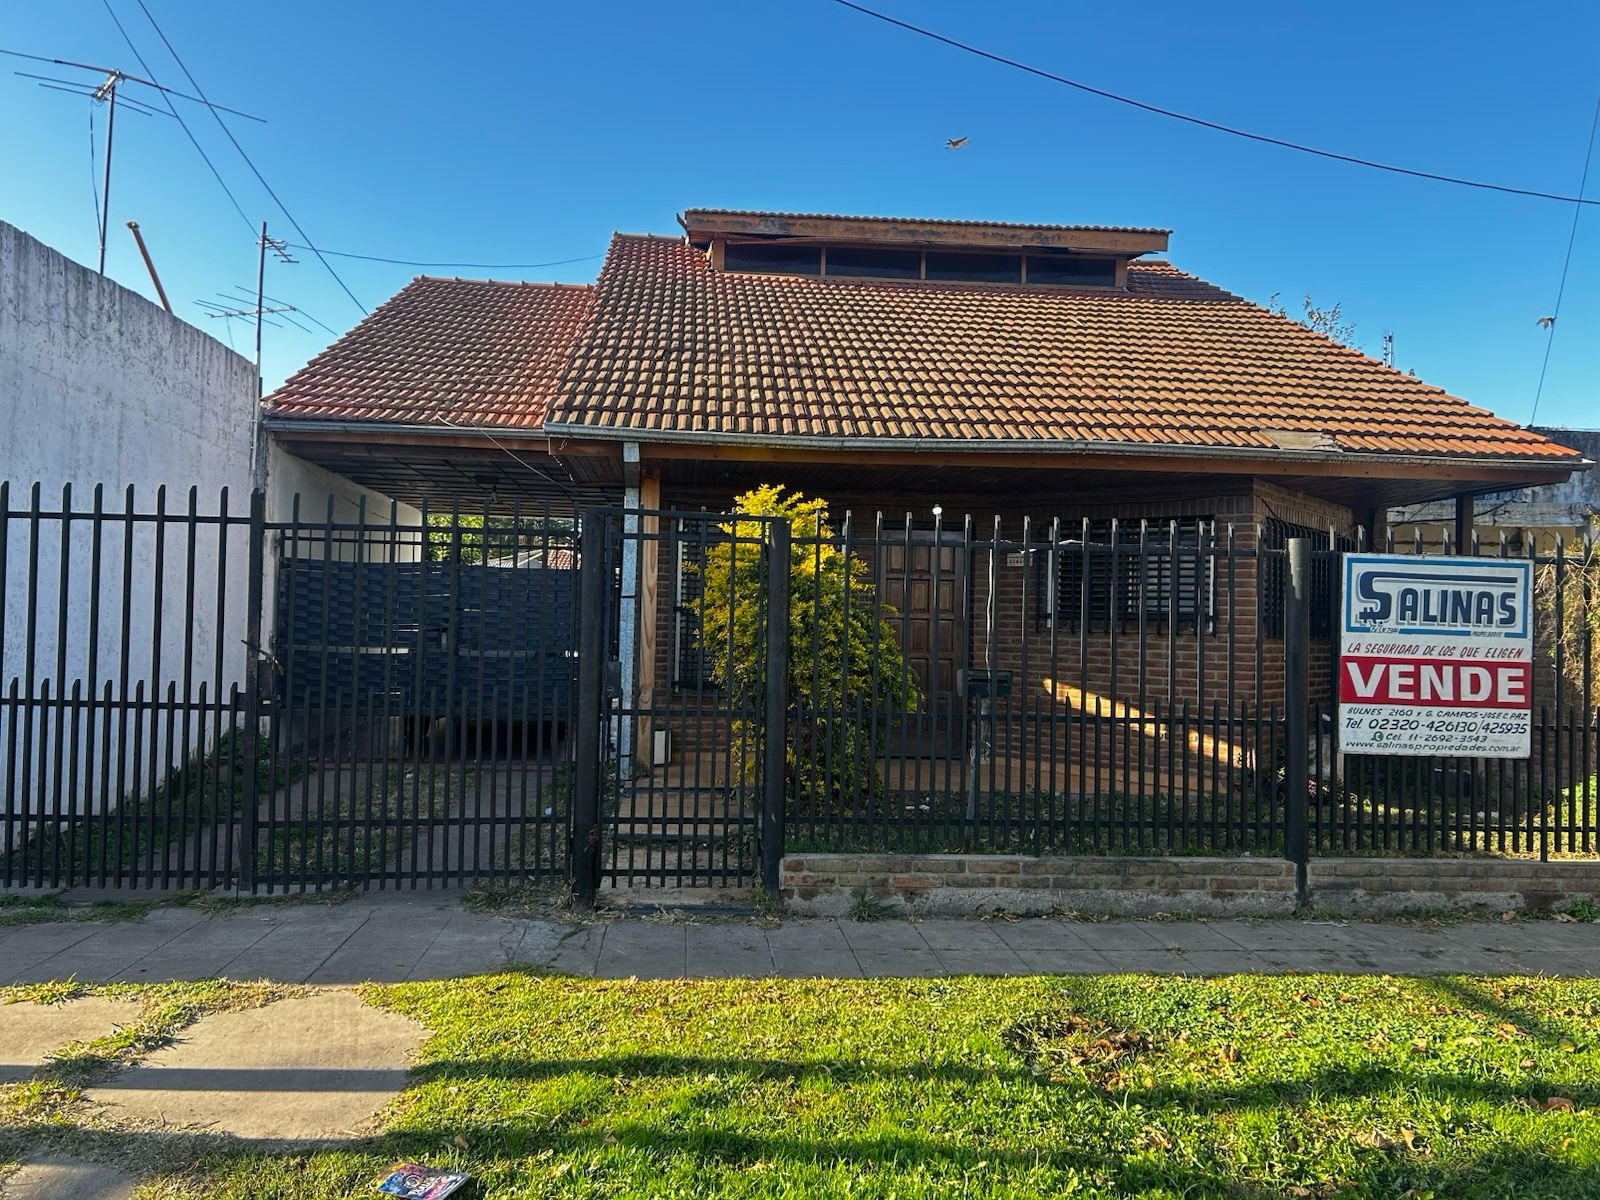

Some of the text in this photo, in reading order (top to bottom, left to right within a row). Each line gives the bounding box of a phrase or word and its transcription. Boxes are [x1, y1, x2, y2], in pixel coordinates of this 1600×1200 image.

[1356, 571, 1517, 628] SALINAS
[1347, 643, 1524, 659] LA SEGURIDAD DE LOS QUE ELIGEN
[1346, 662, 1526, 703] VENDE
[1347, 707, 1383, 716] BULNES
[1389, 708, 1413, 717] 2160
[1510, 712, 1528, 720] PAZ
[1345, 717, 1363, 729] Tel.
[1408, 734, 1488, 742] 11-2692-3543
[1345, 741, 1521, 752] www.salinaspropiedades.com.ar
